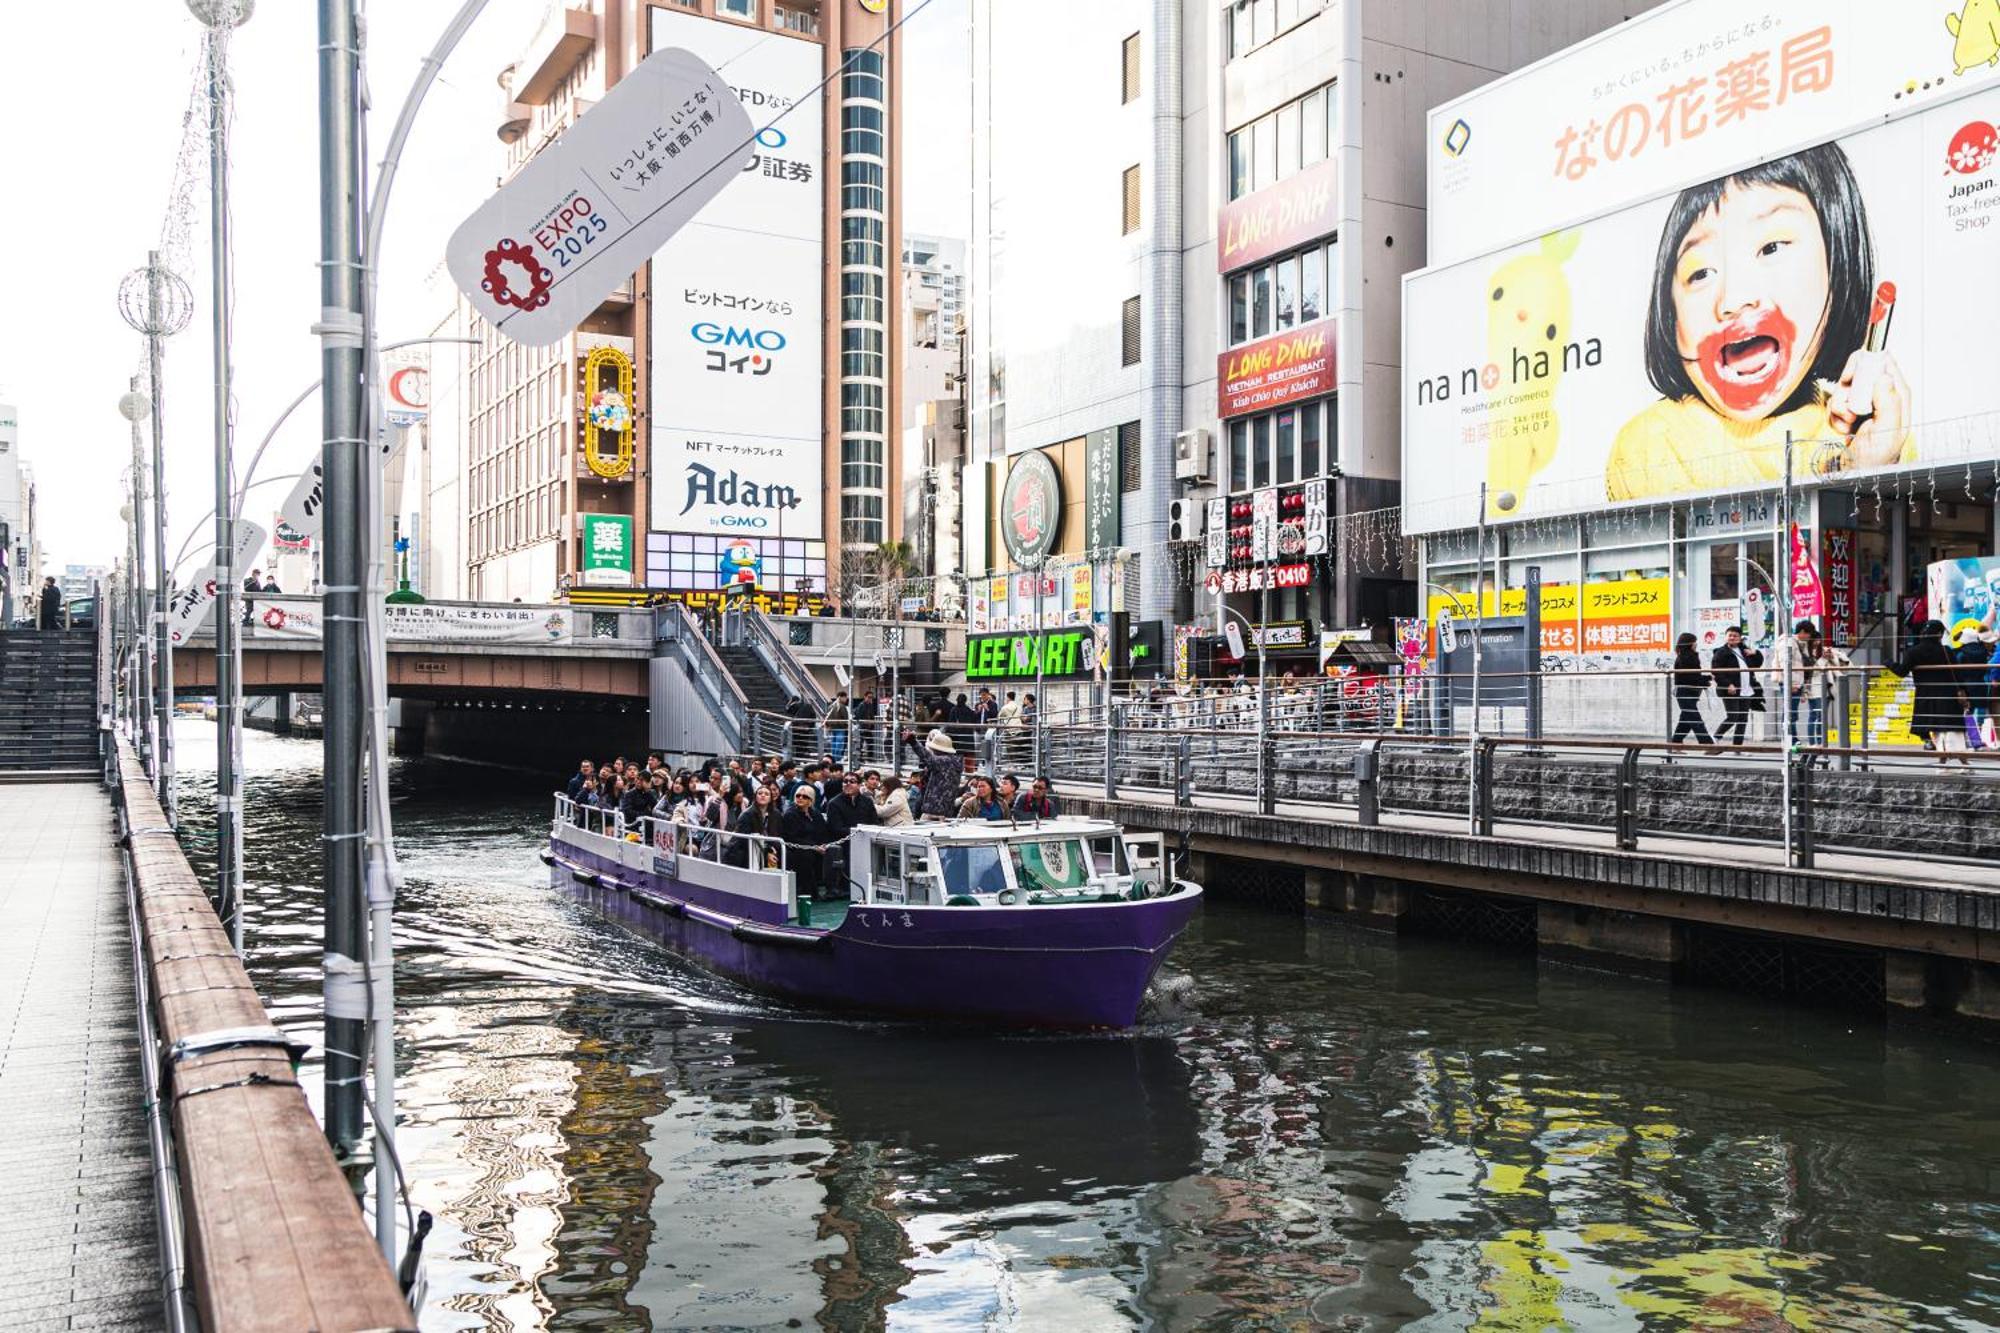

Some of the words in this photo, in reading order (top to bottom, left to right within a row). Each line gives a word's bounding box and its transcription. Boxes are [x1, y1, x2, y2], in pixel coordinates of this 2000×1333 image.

[1554, 25, 1834, 180] なの花薬局
[535, 197, 591, 251] EXPO
[1225, 206, 1271, 257] LONG
[1279, 180, 1330, 230] DINH
[1955, 215, 1990, 232] Shop
[552, 213, 607, 267] 2025
[685, 288, 793, 316] ビットコインなら
[691, 322, 787, 352] GMO
[706, 350, 771, 375] コイン
[1228, 348, 1272, 381] LONG
[1277, 332, 1326, 366] DINH
[1228, 377, 1262, 393] VIETNAM
[1268, 359, 1326, 383] RESTAURANT
[1461, 399, 1502, 415] Healthcare
[1509, 390, 1549, 405] Cosmetics
[685, 441, 713, 452] NFT
[679, 461, 800, 516] Adam
[721, 515, 768, 529] GMO
[1307, 483, 1325, 553] 串かつ
[1592, 590, 1658, 607] ブランドコスメ
[1831, 535, 1849, 647] 欢迎光临
[1585, 623, 1668, 646] 体験型空間
[966, 637, 1007, 676] LEE
[857, 911, 914, 928] てんま
